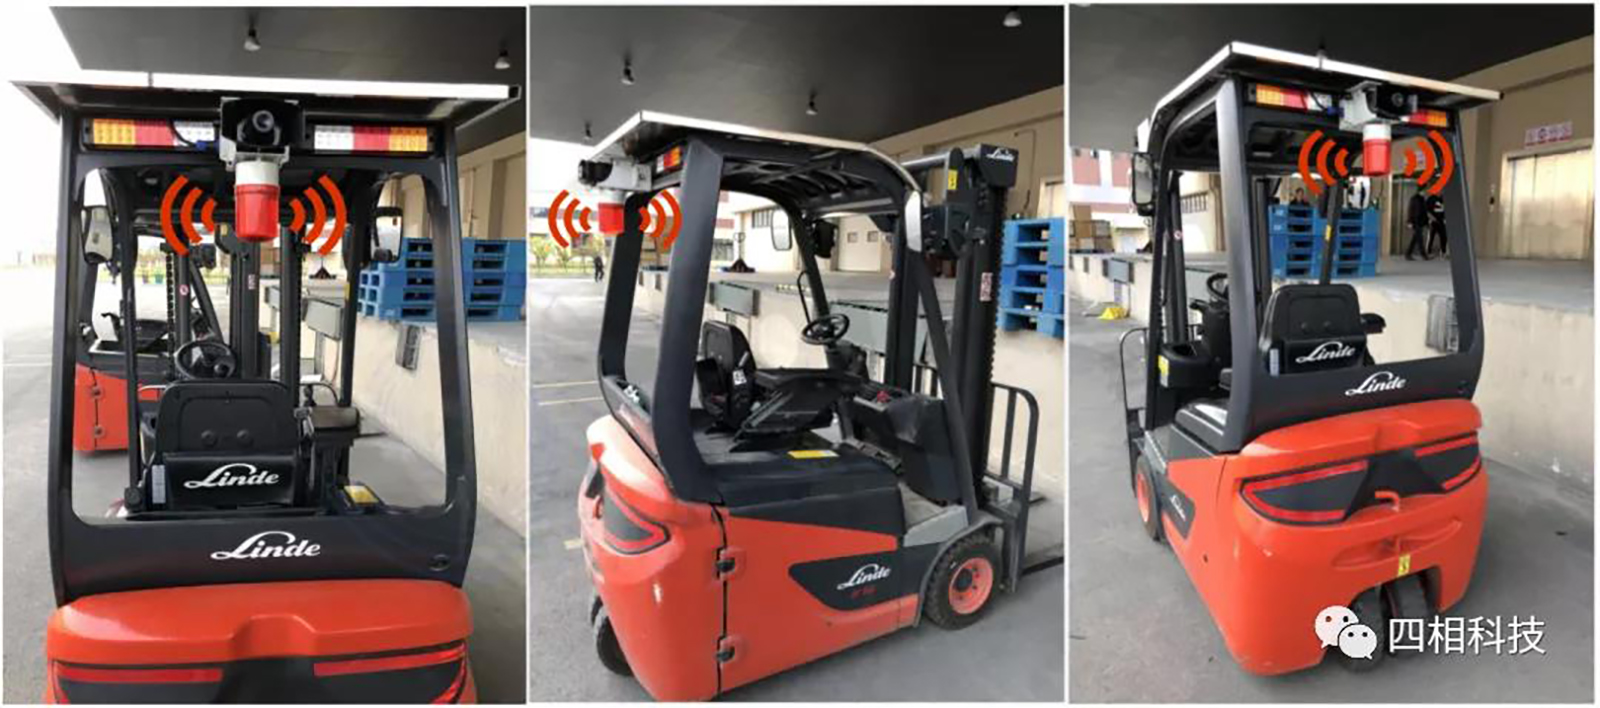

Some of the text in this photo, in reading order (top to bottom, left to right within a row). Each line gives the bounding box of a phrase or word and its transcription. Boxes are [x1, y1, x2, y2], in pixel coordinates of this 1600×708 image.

[1295, 341, 1356, 363] Linde
[1344, 371, 1406, 396] Linde
[184, 463, 280, 489] Linde
[210, 530, 321, 560] Linde
[837, 564, 891, 590] Linde
